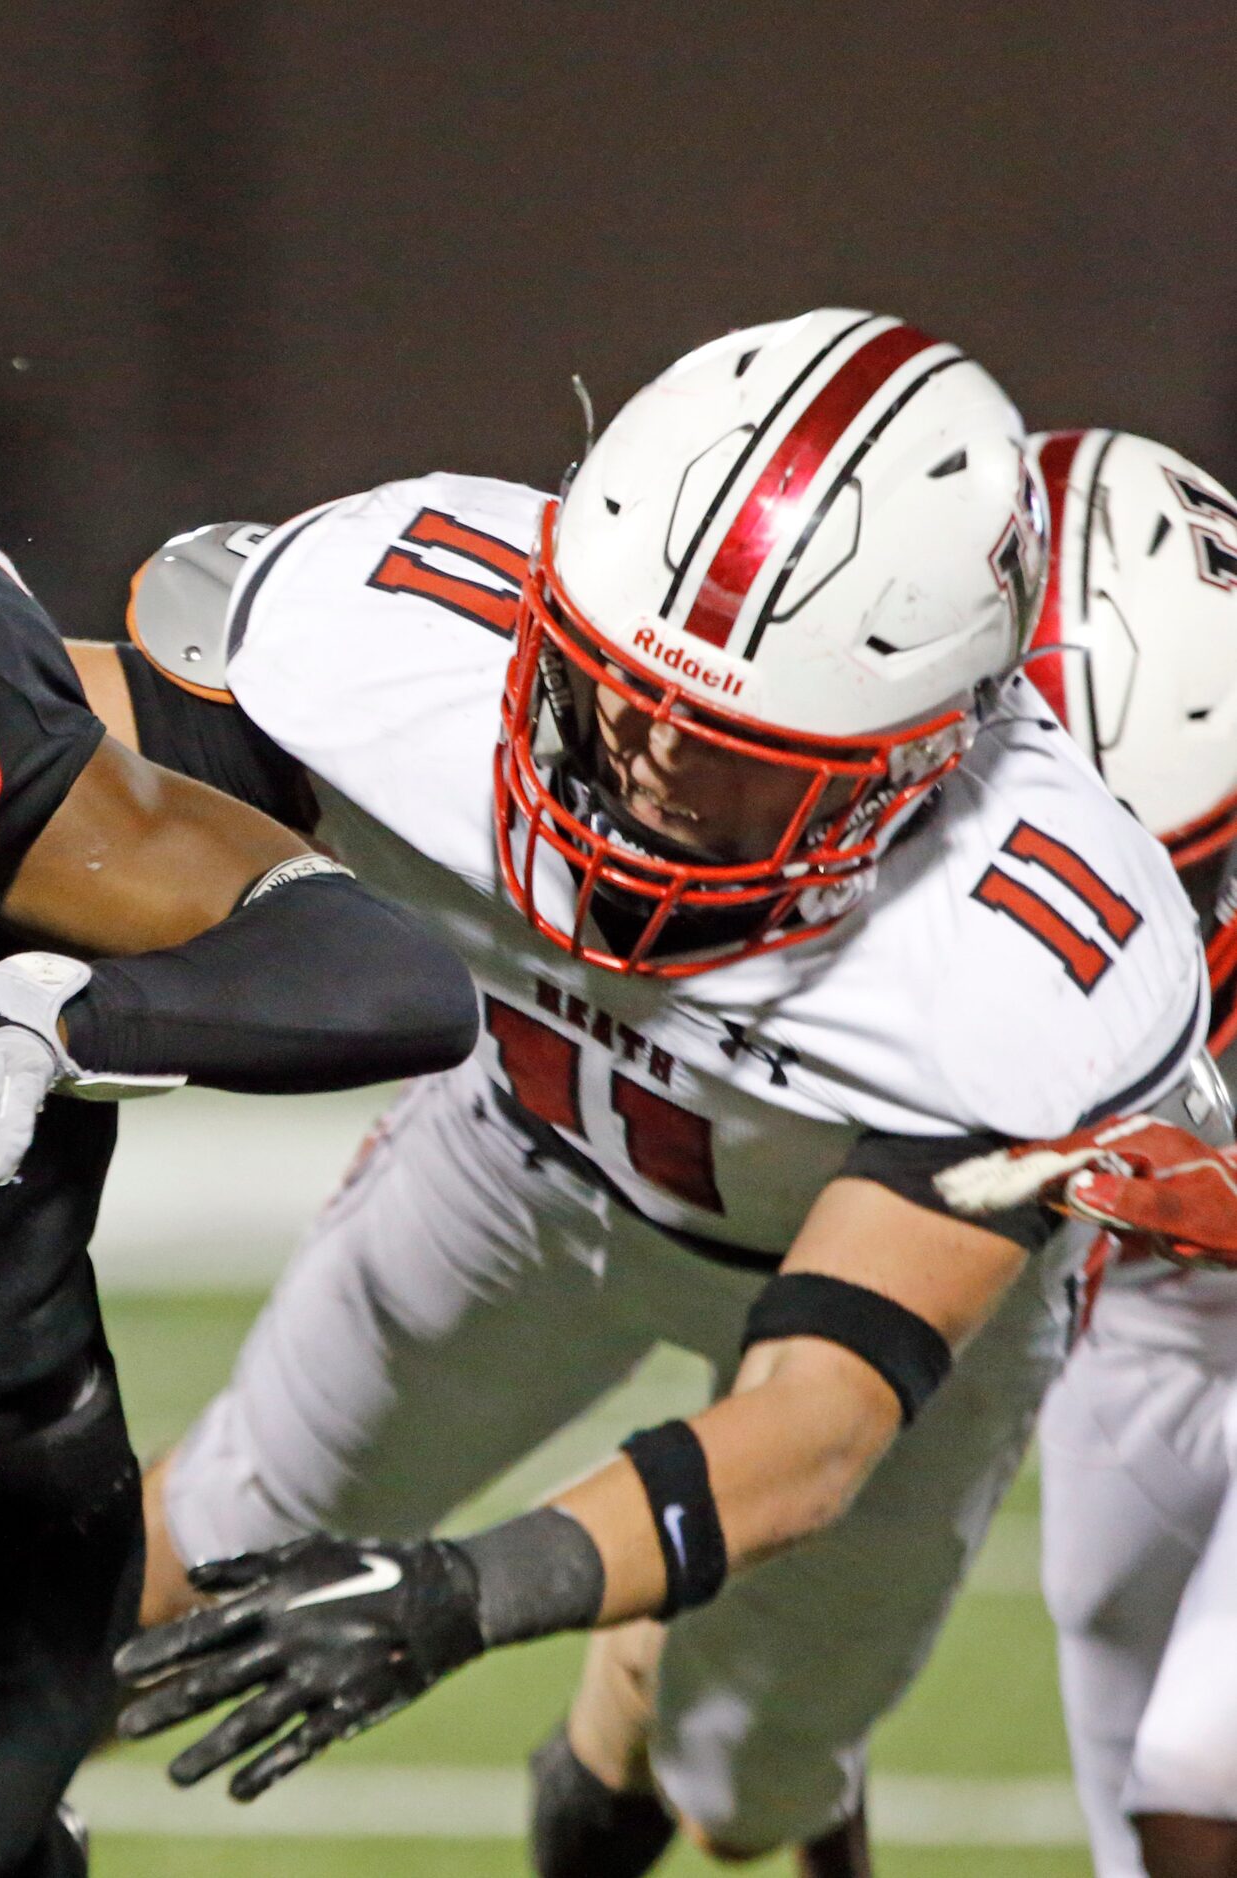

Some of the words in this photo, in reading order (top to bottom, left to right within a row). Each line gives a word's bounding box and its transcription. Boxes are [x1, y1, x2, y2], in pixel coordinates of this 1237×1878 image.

[365, 506, 531, 641] 11
[632, 627, 744, 697] Riddell
[969, 817, 1145, 998] 11
[534, 977, 676, 1089] HEATH
